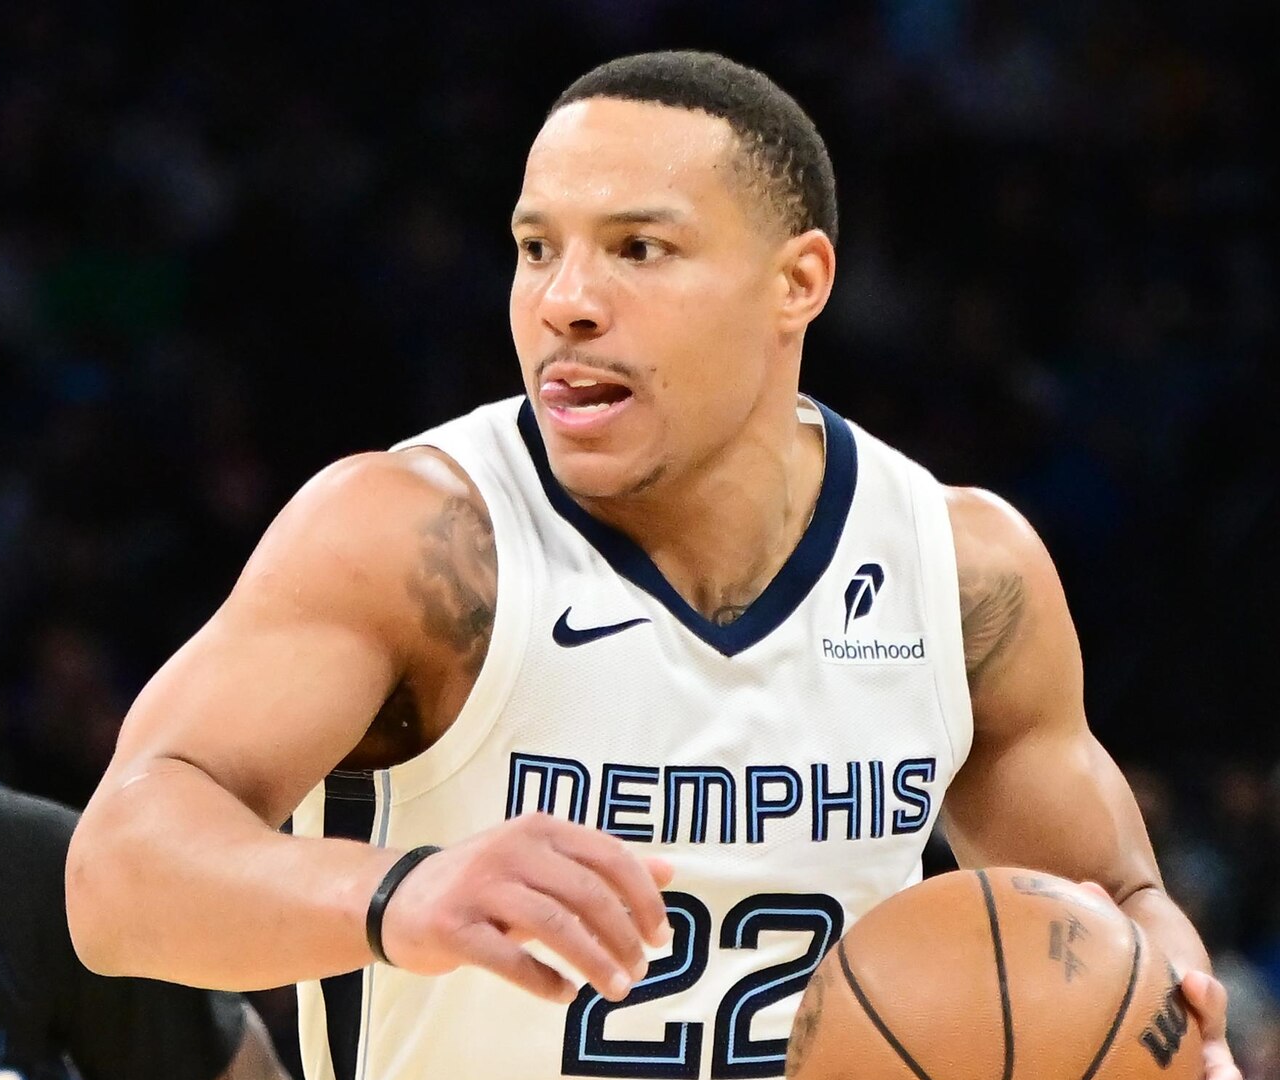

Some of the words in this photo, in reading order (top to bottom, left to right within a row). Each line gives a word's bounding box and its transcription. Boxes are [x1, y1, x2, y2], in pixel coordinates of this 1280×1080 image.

[822, 638, 925, 659] Robinhood
[505, 752, 936, 843] MEMPHIS
[561, 891, 844, 1080] 22
